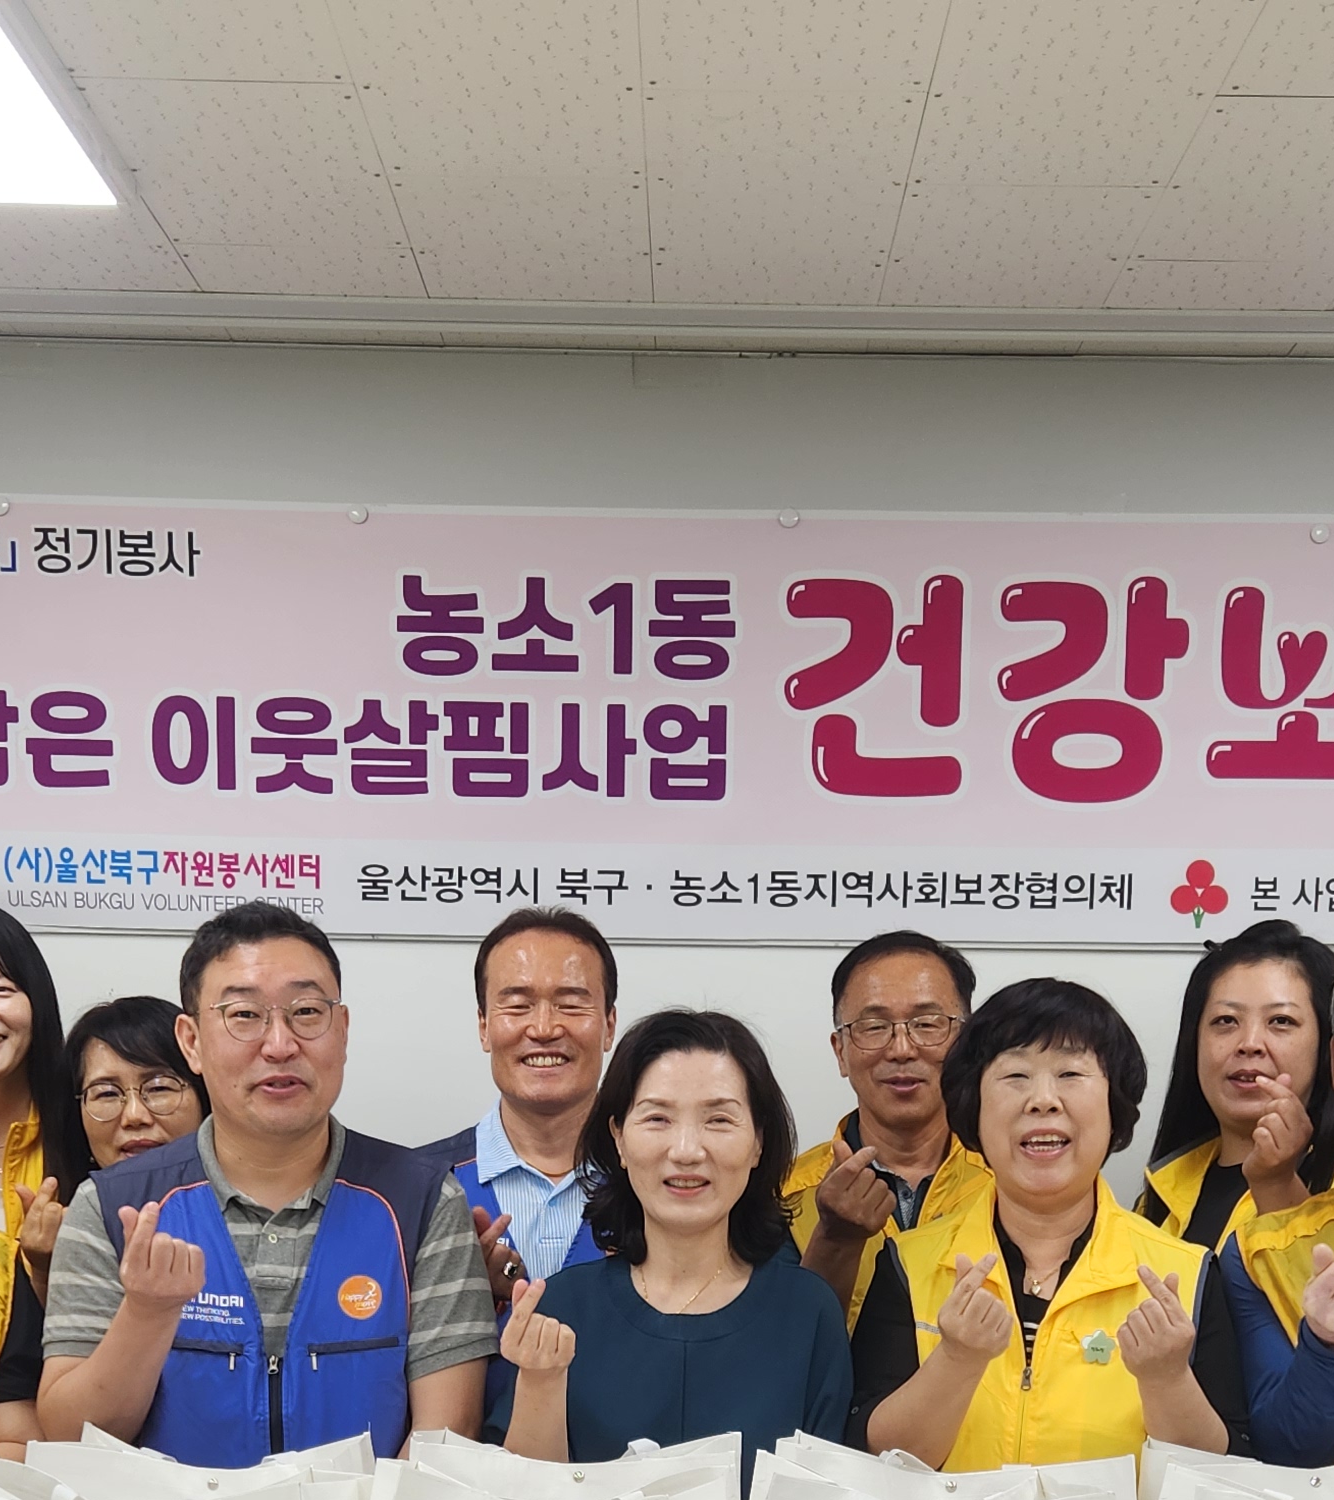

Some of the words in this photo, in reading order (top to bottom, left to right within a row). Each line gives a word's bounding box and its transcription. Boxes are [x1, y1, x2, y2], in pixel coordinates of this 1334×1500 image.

[33, 527, 201, 580] 정기봉사
[396, 574, 737, 681] 농소1동
[151, 694, 728, 802] 이웃살핌사업
[4, 846, 321, 889] (사)울산북구자원봉사센터
[356, 863, 540, 905] 울산광역시
[555, 867, 629, 906] 북구
[669, 870, 1134, 911] 농소1동지역사회보장협의체
[8, 890, 67, 908] ULSAN
[74, 892, 135, 910] BUKGU
[1250, 876, 1281, 912] 본
